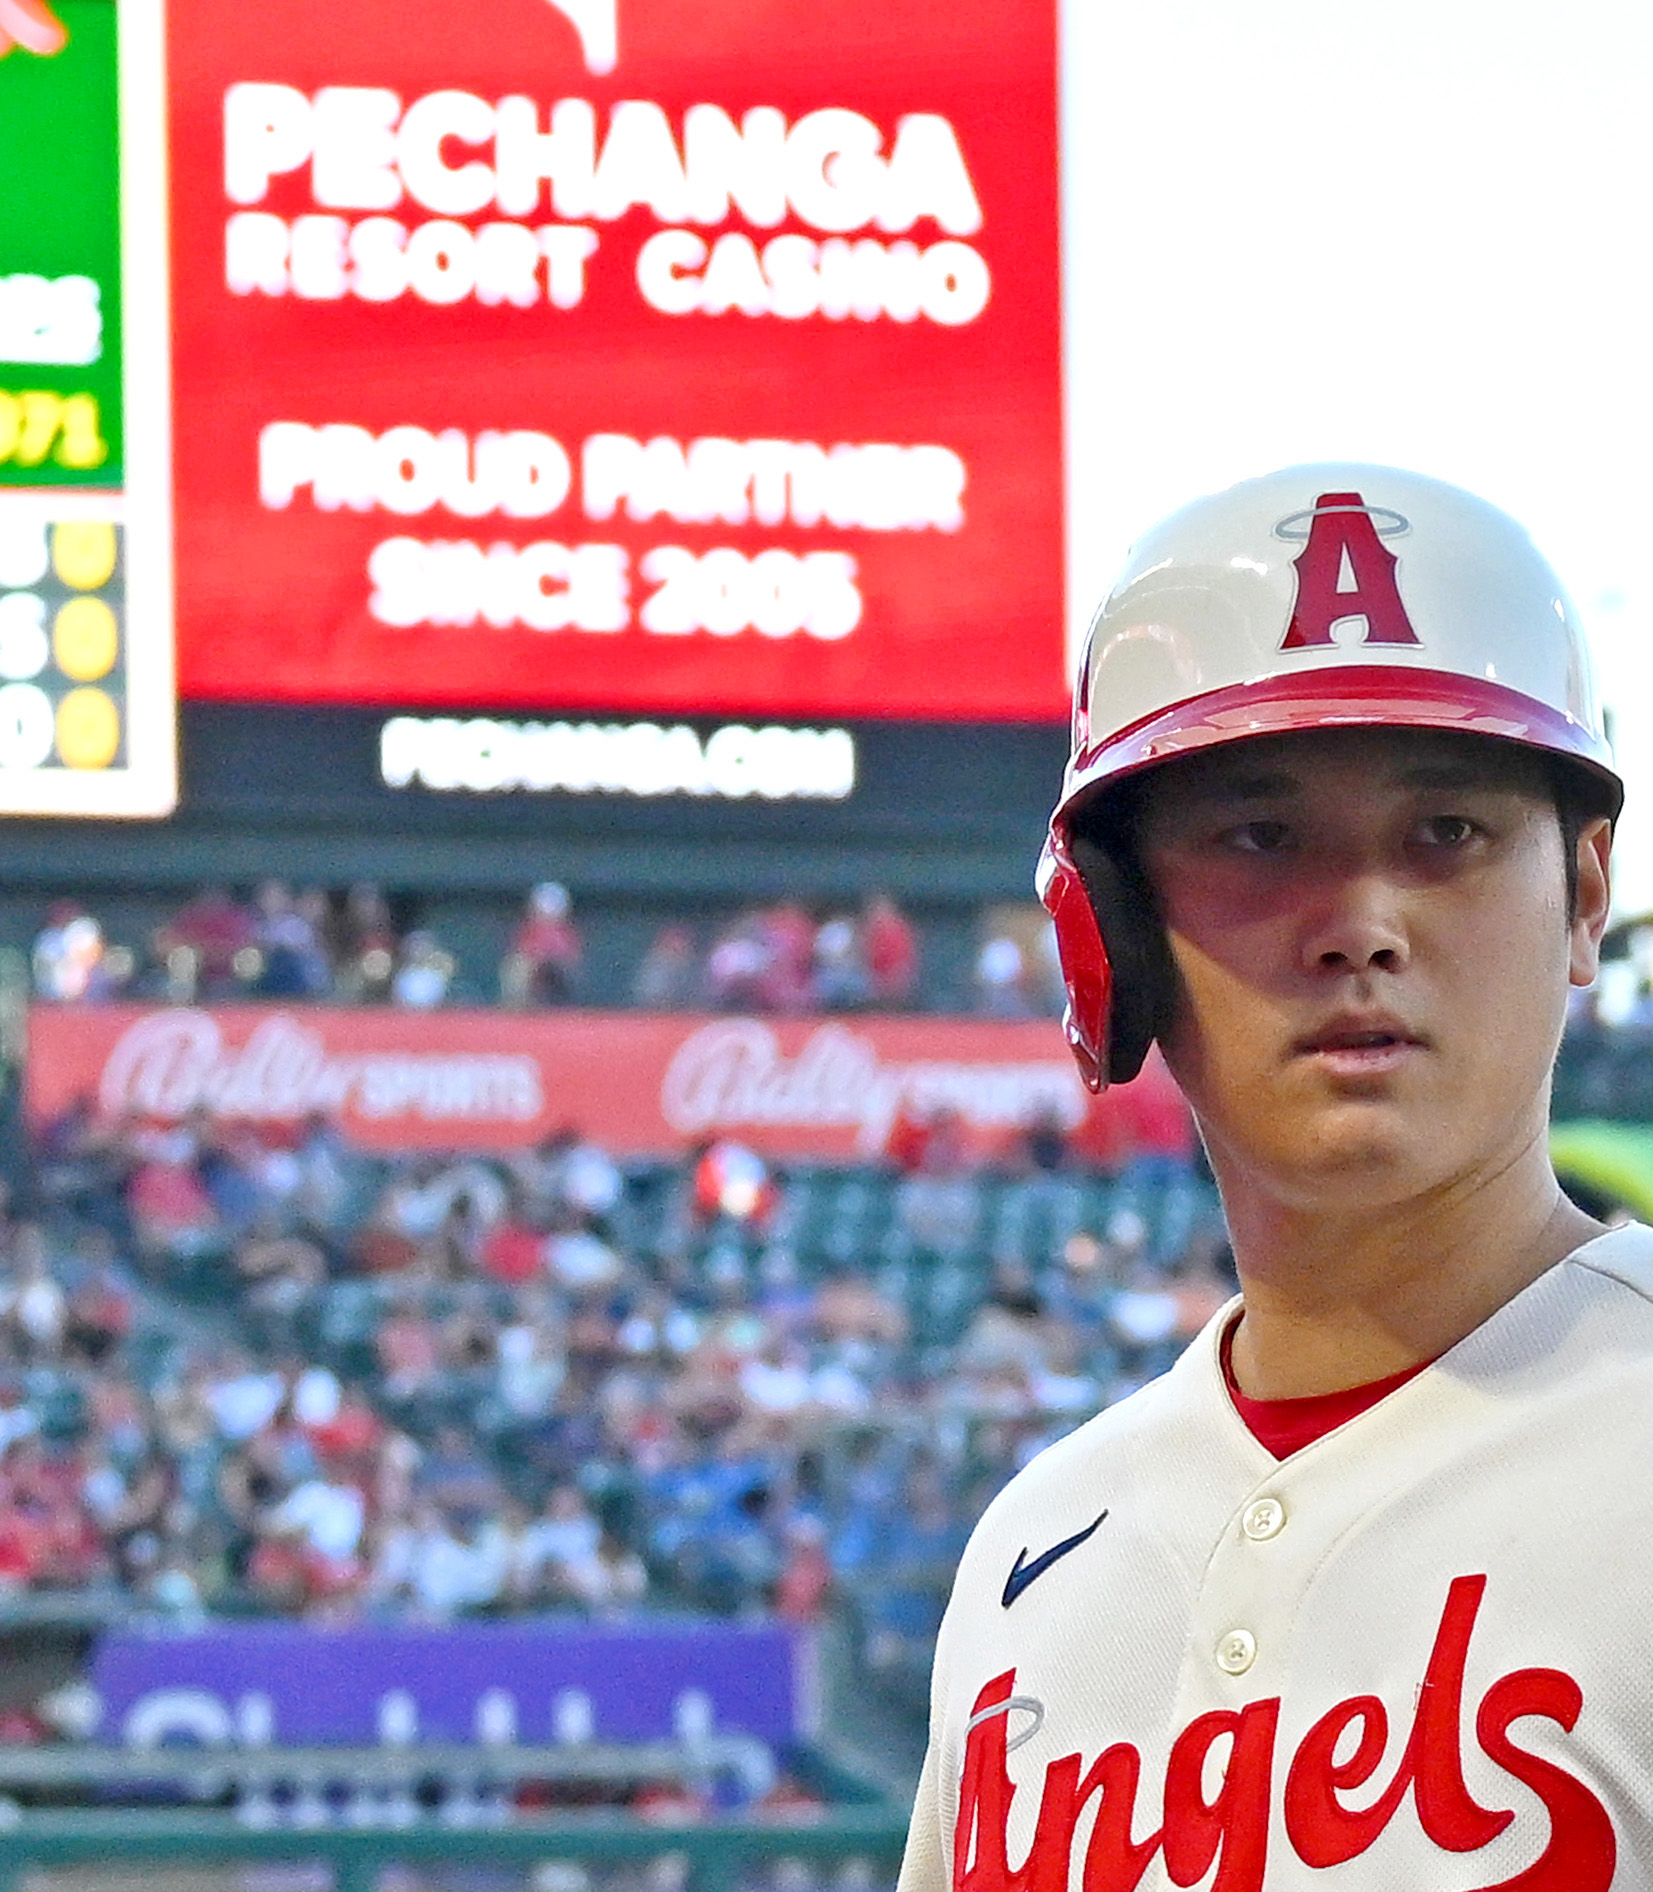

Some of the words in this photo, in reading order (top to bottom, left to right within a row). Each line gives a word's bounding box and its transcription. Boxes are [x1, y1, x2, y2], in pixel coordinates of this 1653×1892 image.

[227, 83, 981, 234] PECHANGA
[227, 213, 596, 305] RESORT
[638, 231, 990, 324] CASINO
[260, 423, 570, 517] PROUD
[583, 434, 966, 530] PARTNER
[370, 538, 627, 631] SINCE
[644, 547, 862, 639] 2005
[1275, 491, 1423, 651] A
